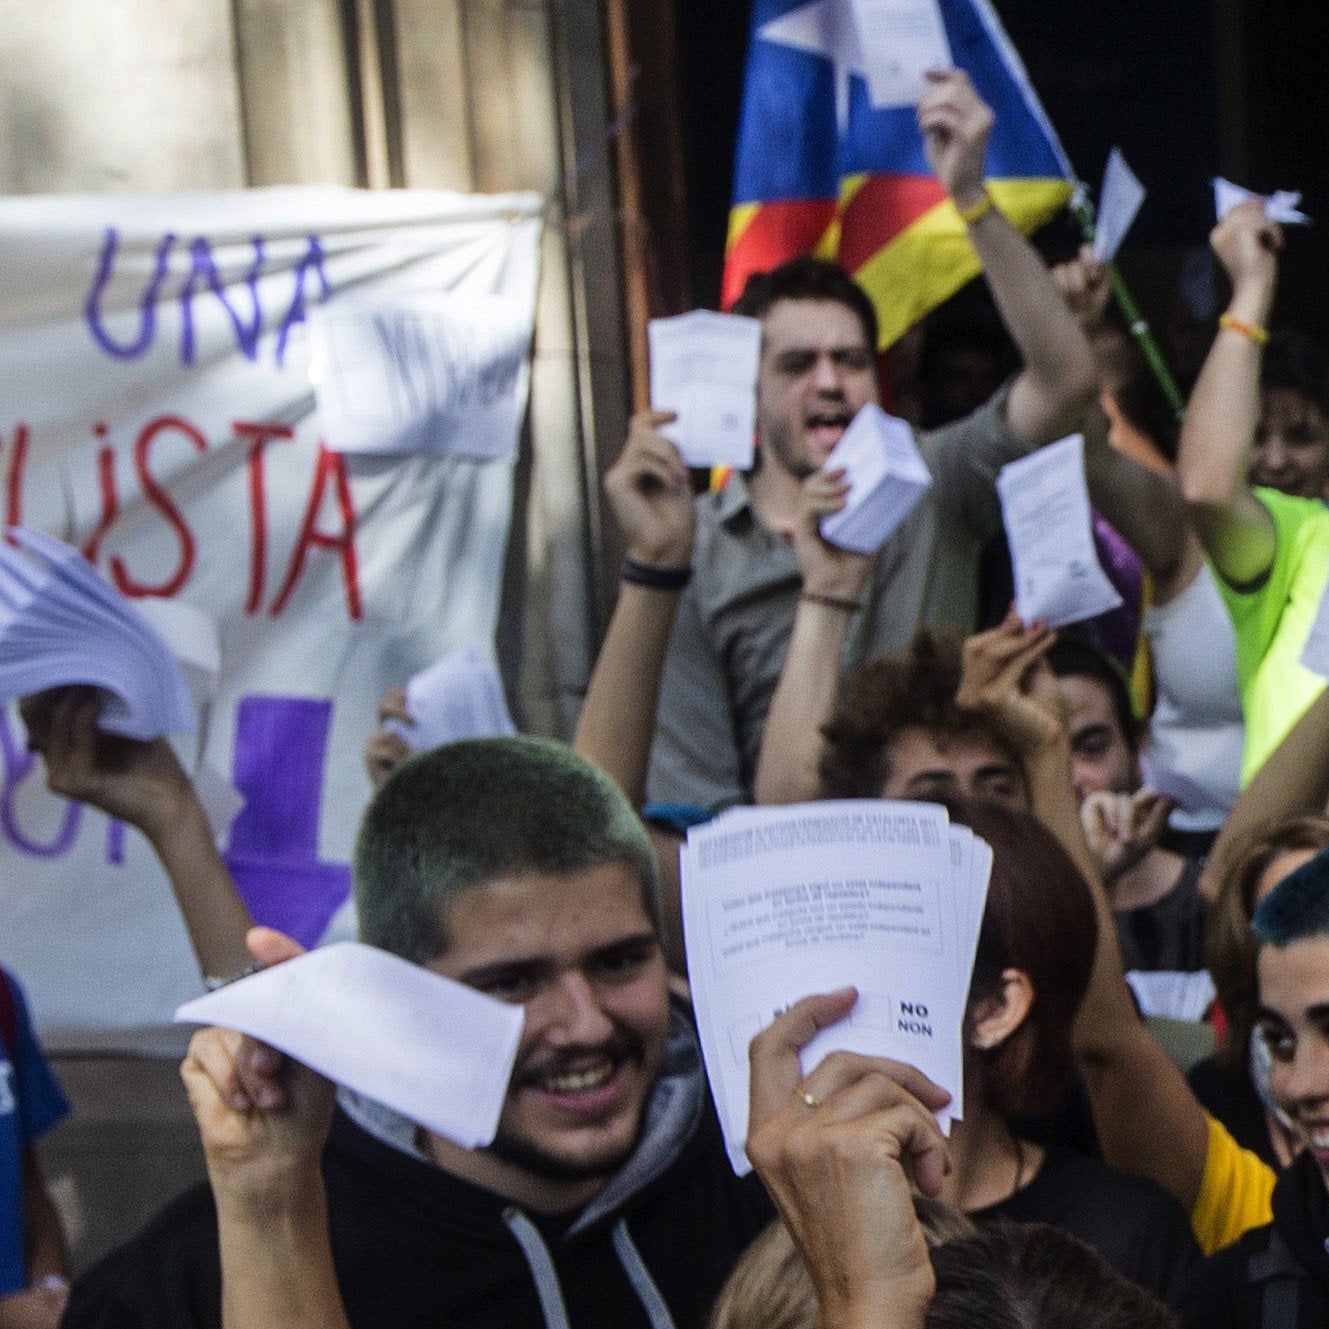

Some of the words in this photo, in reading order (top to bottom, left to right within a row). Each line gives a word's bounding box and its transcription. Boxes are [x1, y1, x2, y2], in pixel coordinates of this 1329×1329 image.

[85, 227, 331, 367] UNA
[899, 1000, 929, 1018] NO
[897, 1021, 934, 1038] NON
